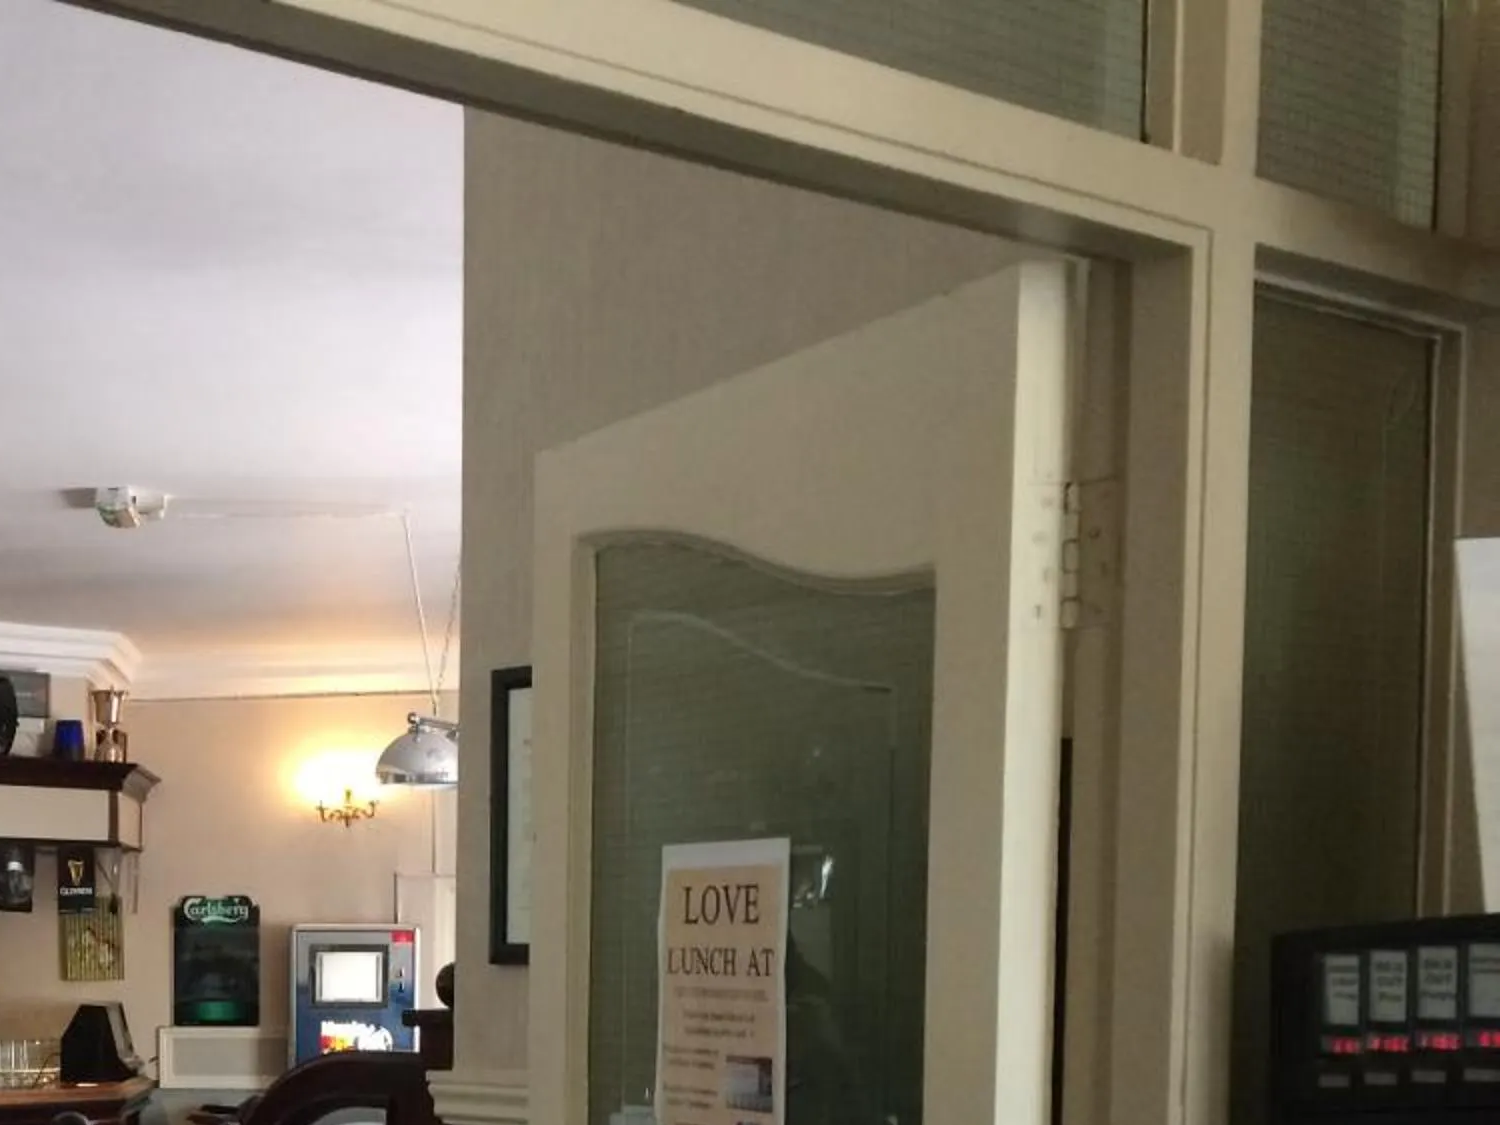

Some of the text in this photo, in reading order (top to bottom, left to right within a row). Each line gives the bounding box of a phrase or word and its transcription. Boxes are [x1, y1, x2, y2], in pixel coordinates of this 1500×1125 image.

[182, 898, 251, 923] Carlsberg
[683, 882, 760, 926] LOVE
[666, 946, 776, 978] LUNCH AT
